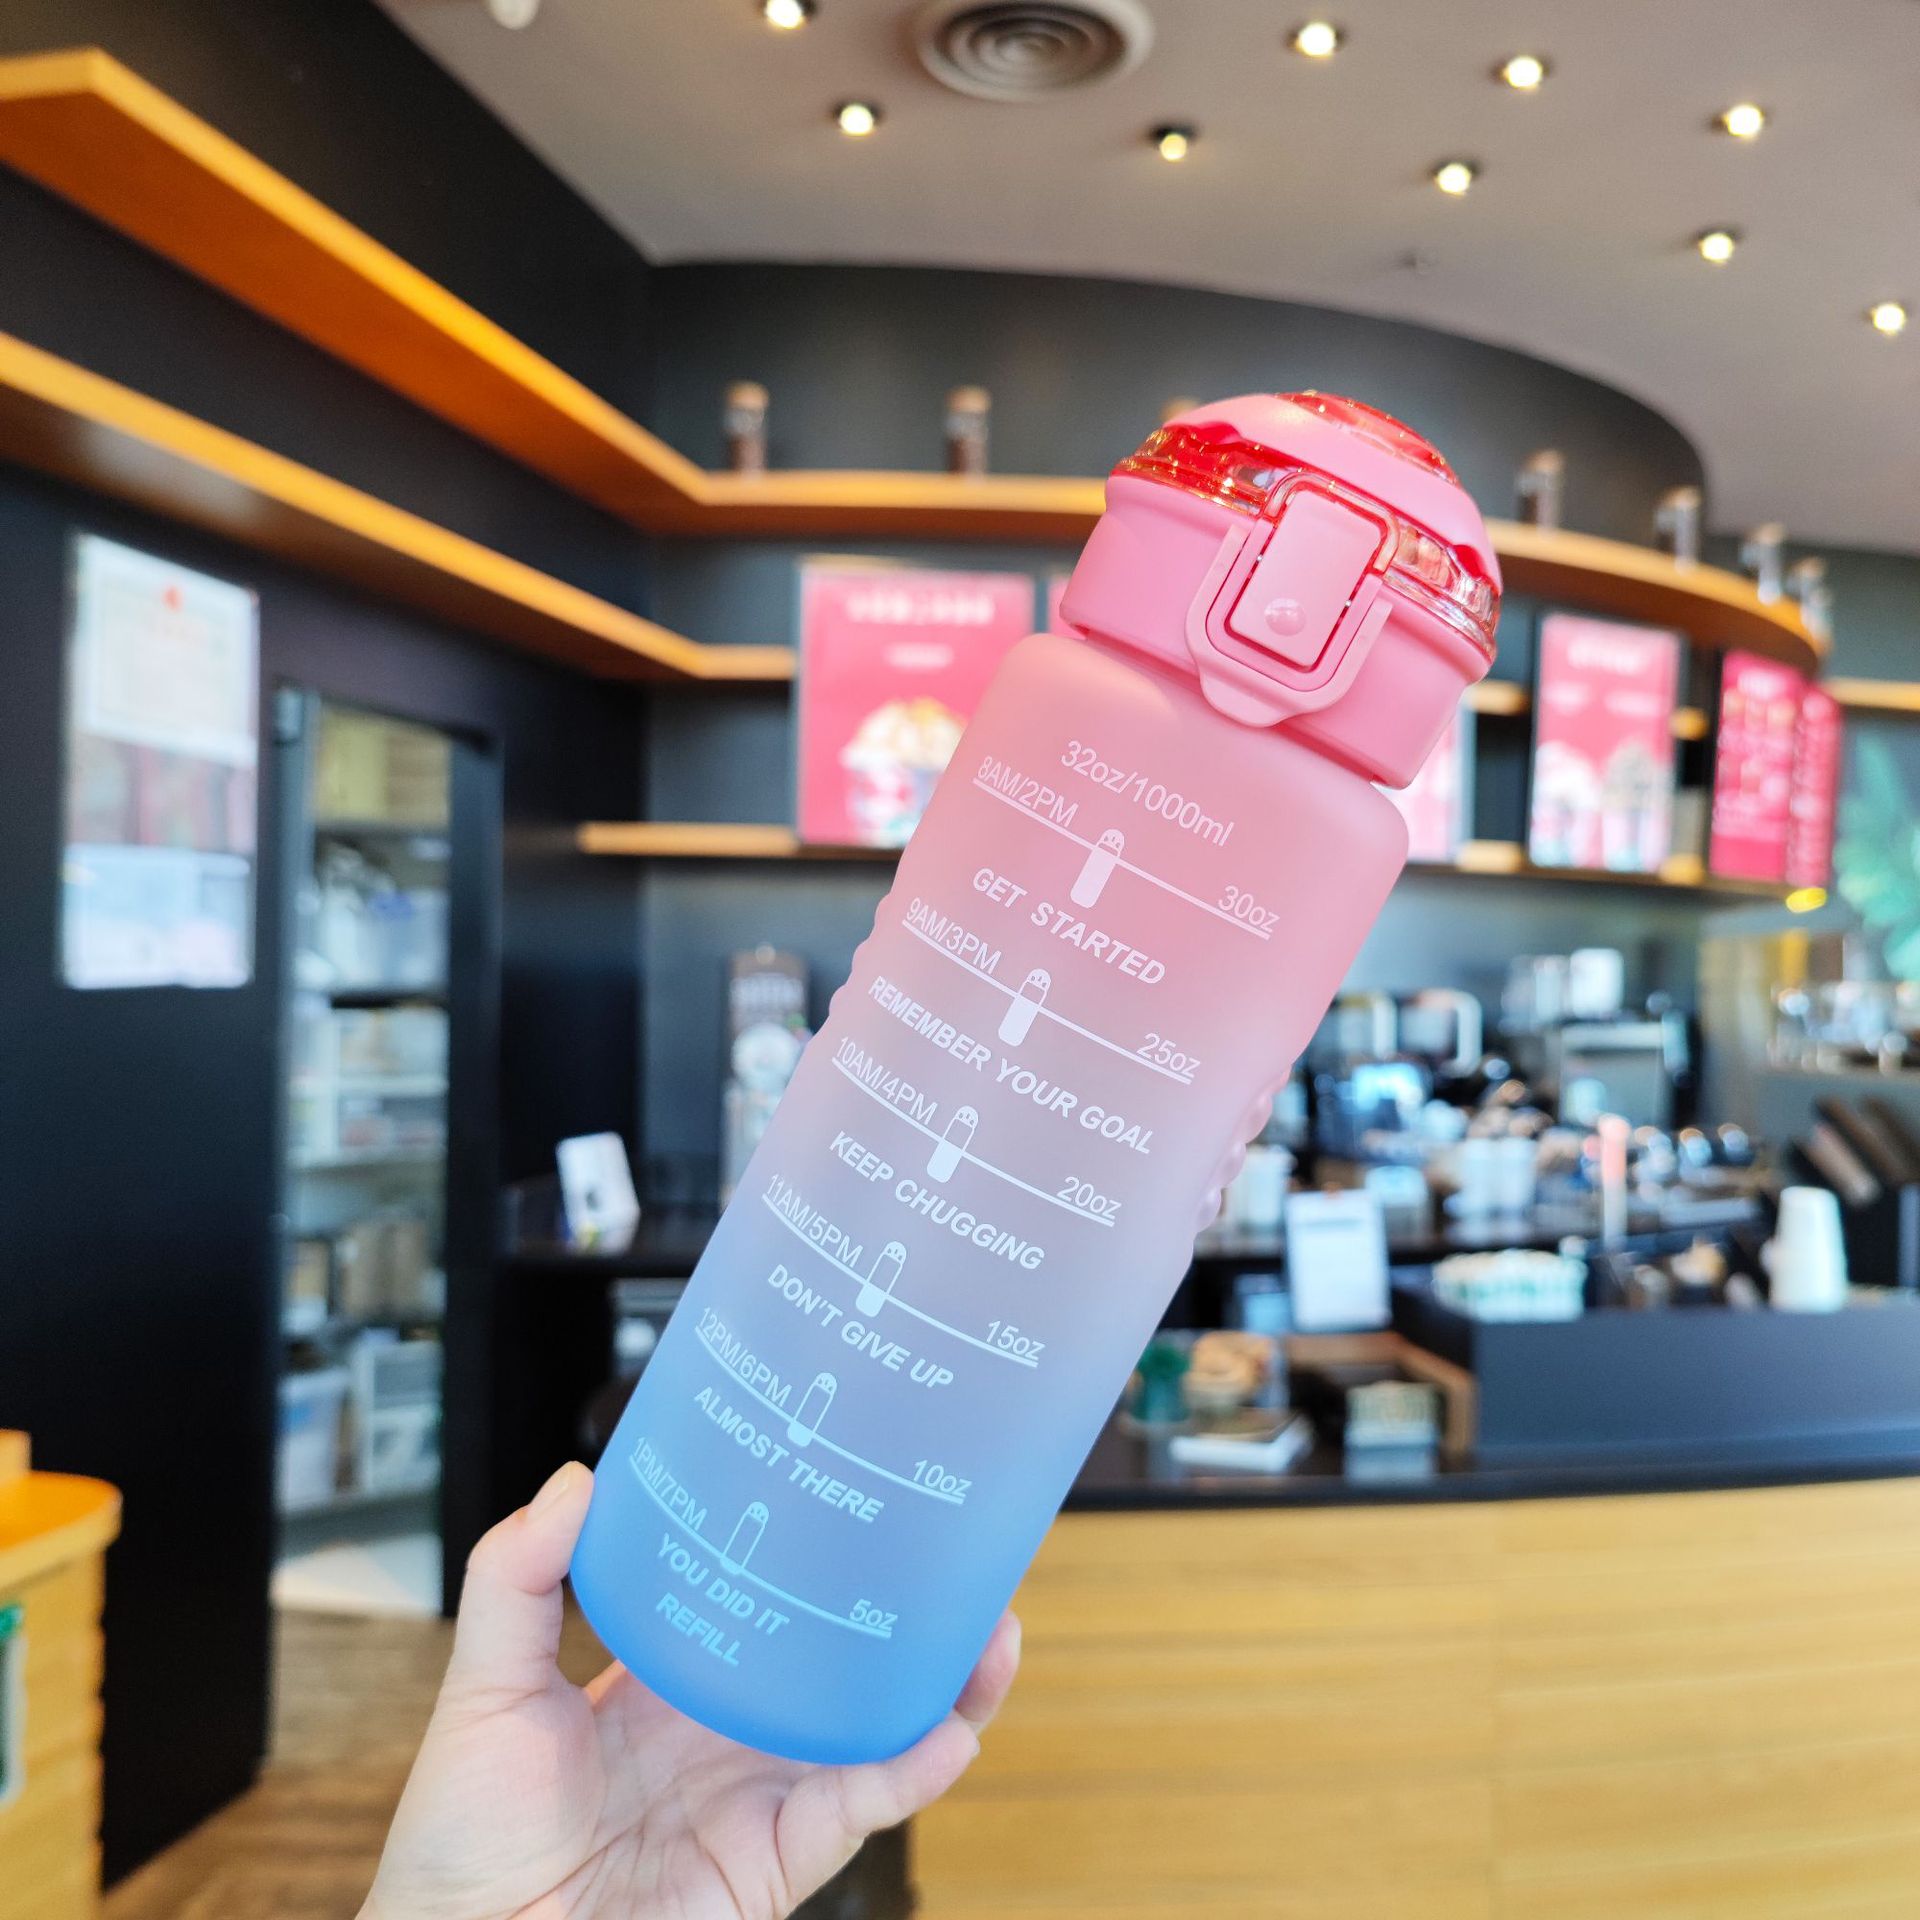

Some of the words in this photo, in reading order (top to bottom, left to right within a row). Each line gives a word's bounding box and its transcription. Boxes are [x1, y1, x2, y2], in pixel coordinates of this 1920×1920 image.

[978, 756, 1079, 828] 8AM/2PM
[1060, 740, 1235, 847] 32oz/1000ml
[906, 898, 1001, 975] 9AM/3PM
[973, 867, 1027, 909] GET
[1030, 902, 1166, 985] STARTED
[1218, 885, 1281, 934] 30oz
[835, 1036, 938, 1125] 10AM/4PM
[868, 975, 992, 1072] REMEMBER
[995, 1058, 1078, 1118] YOUR
[1079, 1105, 1155, 1155] GOAL
[1137, 1033, 1201, 1079] 25oz
[766, 1173, 864, 1268] 11AM/5PM
[829, 1131, 894, 1183] KEEP
[895, 1179, 1045, 1270] CHUGGING
[1057, 1176, 1121, 1220] 20oz
[699, 1307, 792, 1407] 12PM/6PM
[768, 1264, 844, 1327] DON'T
[841, 1320, 911, 1372] GIVE
[910, 1359, 954, 1390] UP
[986, 1320, 1046, 1361] 15oz
[634, 1437, 708, 1531] 1PM/7PM
[694, 1386, 790, 1468] ALMOST
[789, 1459, 885, 1523] THERE
[913, 1459, 972, 1498] 10oz
[655, 1592, 740, 1667] REFILL
[657, 1533, 710, 1586] YOU
[705, 1577, 756, 1619] DID
[755, 1612, 790, 1636] IT
[850, 1599, 898, 1632] 5oz
